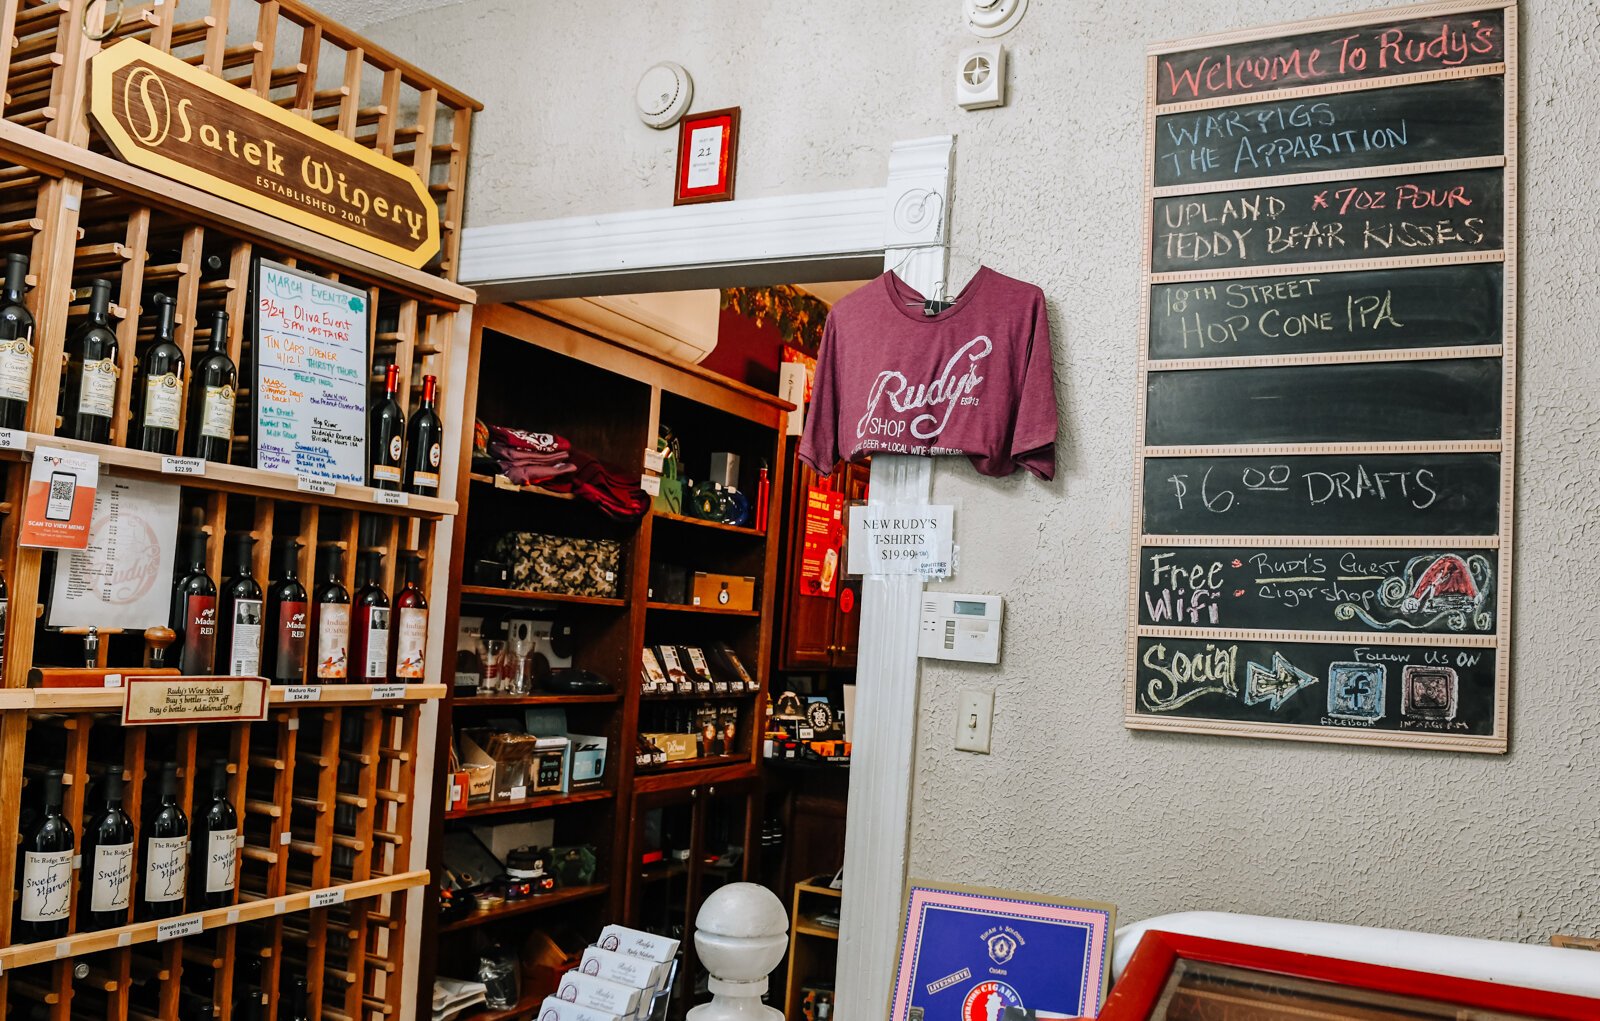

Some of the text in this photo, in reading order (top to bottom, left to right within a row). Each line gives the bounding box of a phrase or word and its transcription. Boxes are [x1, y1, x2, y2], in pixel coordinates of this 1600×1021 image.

[1166, 20, 1494, 96] Welcome To Rudy's
[697, 147, 712, 157] 21
[1162, 119, 1408, 176] THE APPARITION
[177, 98, 424, 241] Satek Winery
[256, 175, 368, 228] ESTABLISHED 2001
[1165, 194, 1286, 228] UPLAND
[1396, 184, 1472, 210] POUR
[1158, 217, 1484, 261] TEDDY BEAR KISSES
[267, 272, 348, 304] MARCH EVENTS
[1226, 278, 1321, 309] STREET
[294, 305, 319, 324] Oliva
[322, 312, 353, 331] Event
[1180, 289, 1404, 349] HOP CONE IPA
[264, 335, 338, 361] TIN CAPS OPENER
[857, 336, 992, 439] Rudy's
[869, 417, 906, 438] SHOP
[862, 439, 879, 449] BEER
[887, 442, 909, 454] LOCAL
[166, 458, 200, 467] Chardonnay
[1301, 464, 1437, 509] DRAFTS
[863, 518, 937, 530] NEW RUDY'S
[873, 534, 925, 545] T-SHIRTS
[881, 549, 914, 561] $19.99
[1150, 552, 1224, 590] Free
[200, 627, 214, 635] RED
[291, 630, 305, 638] RED
[1456, 652, 1482, 668] ON
[1143, 643, 1240, 704] Social
[165, 697, 178, 705] Buy
[220, 695, 230, 704] off
[167, 687, 187, 697] Rudy's
[205, 687, 224, 695] Special
[149, 706, 162, 715] Buy
[168, 705, 187, 713] bottles
[193, 704, 222, 713] Additional
[233, 703, 242, 713] off
[98, 864, 127, 881] Sweet
[151, 857, 179, 872] Sweet
[26, 873, 57, 888] Sweet
[328, 890, 339, 898] Jack
[159, 918, 199, 932] Sweet Harvest
[169, 928, 189, 937] $19.99
[981, 983, 1017, 1003] CIGARS
